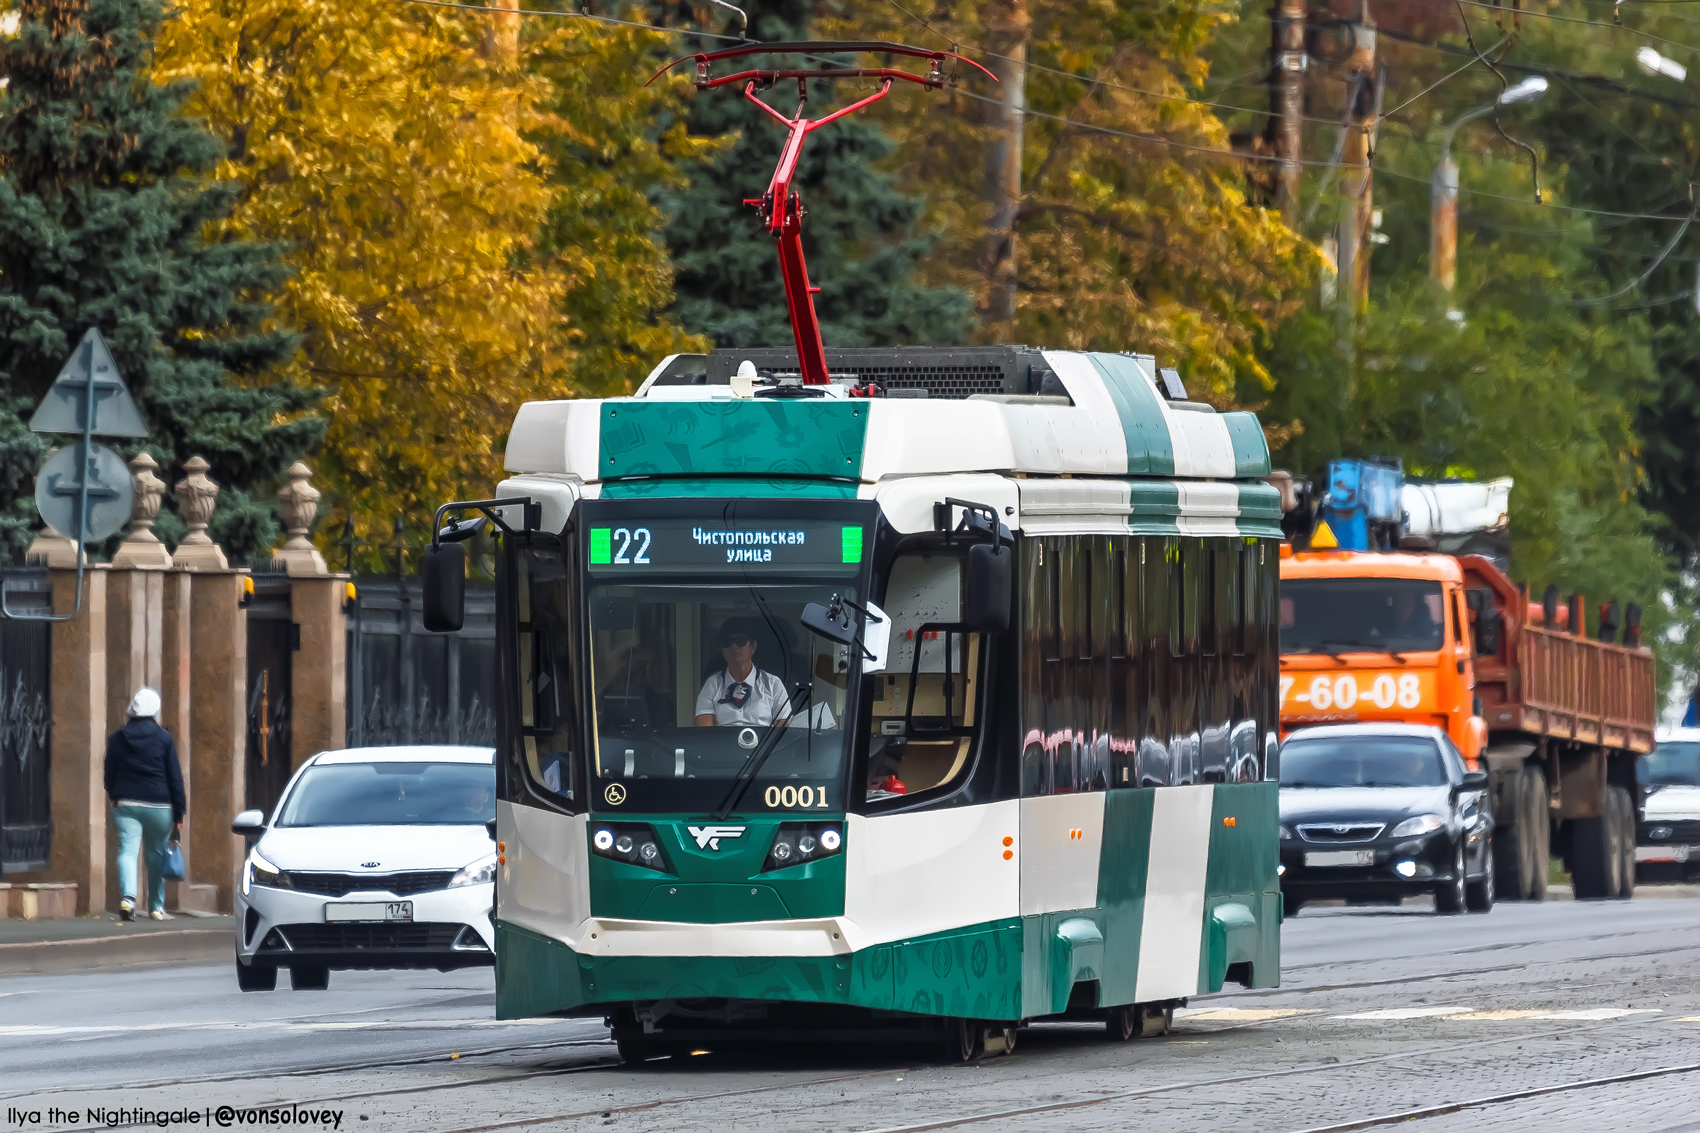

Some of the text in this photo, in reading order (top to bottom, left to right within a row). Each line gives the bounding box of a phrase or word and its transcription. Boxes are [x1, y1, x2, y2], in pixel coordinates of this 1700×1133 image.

[692, 527, 805, 545] Чистопольская
[613, 528, 650, 564] 22
[726, 548, 772, 563] улица
[765, 785, 829, 807] 0001
[387, 904, 409, 915] 174
